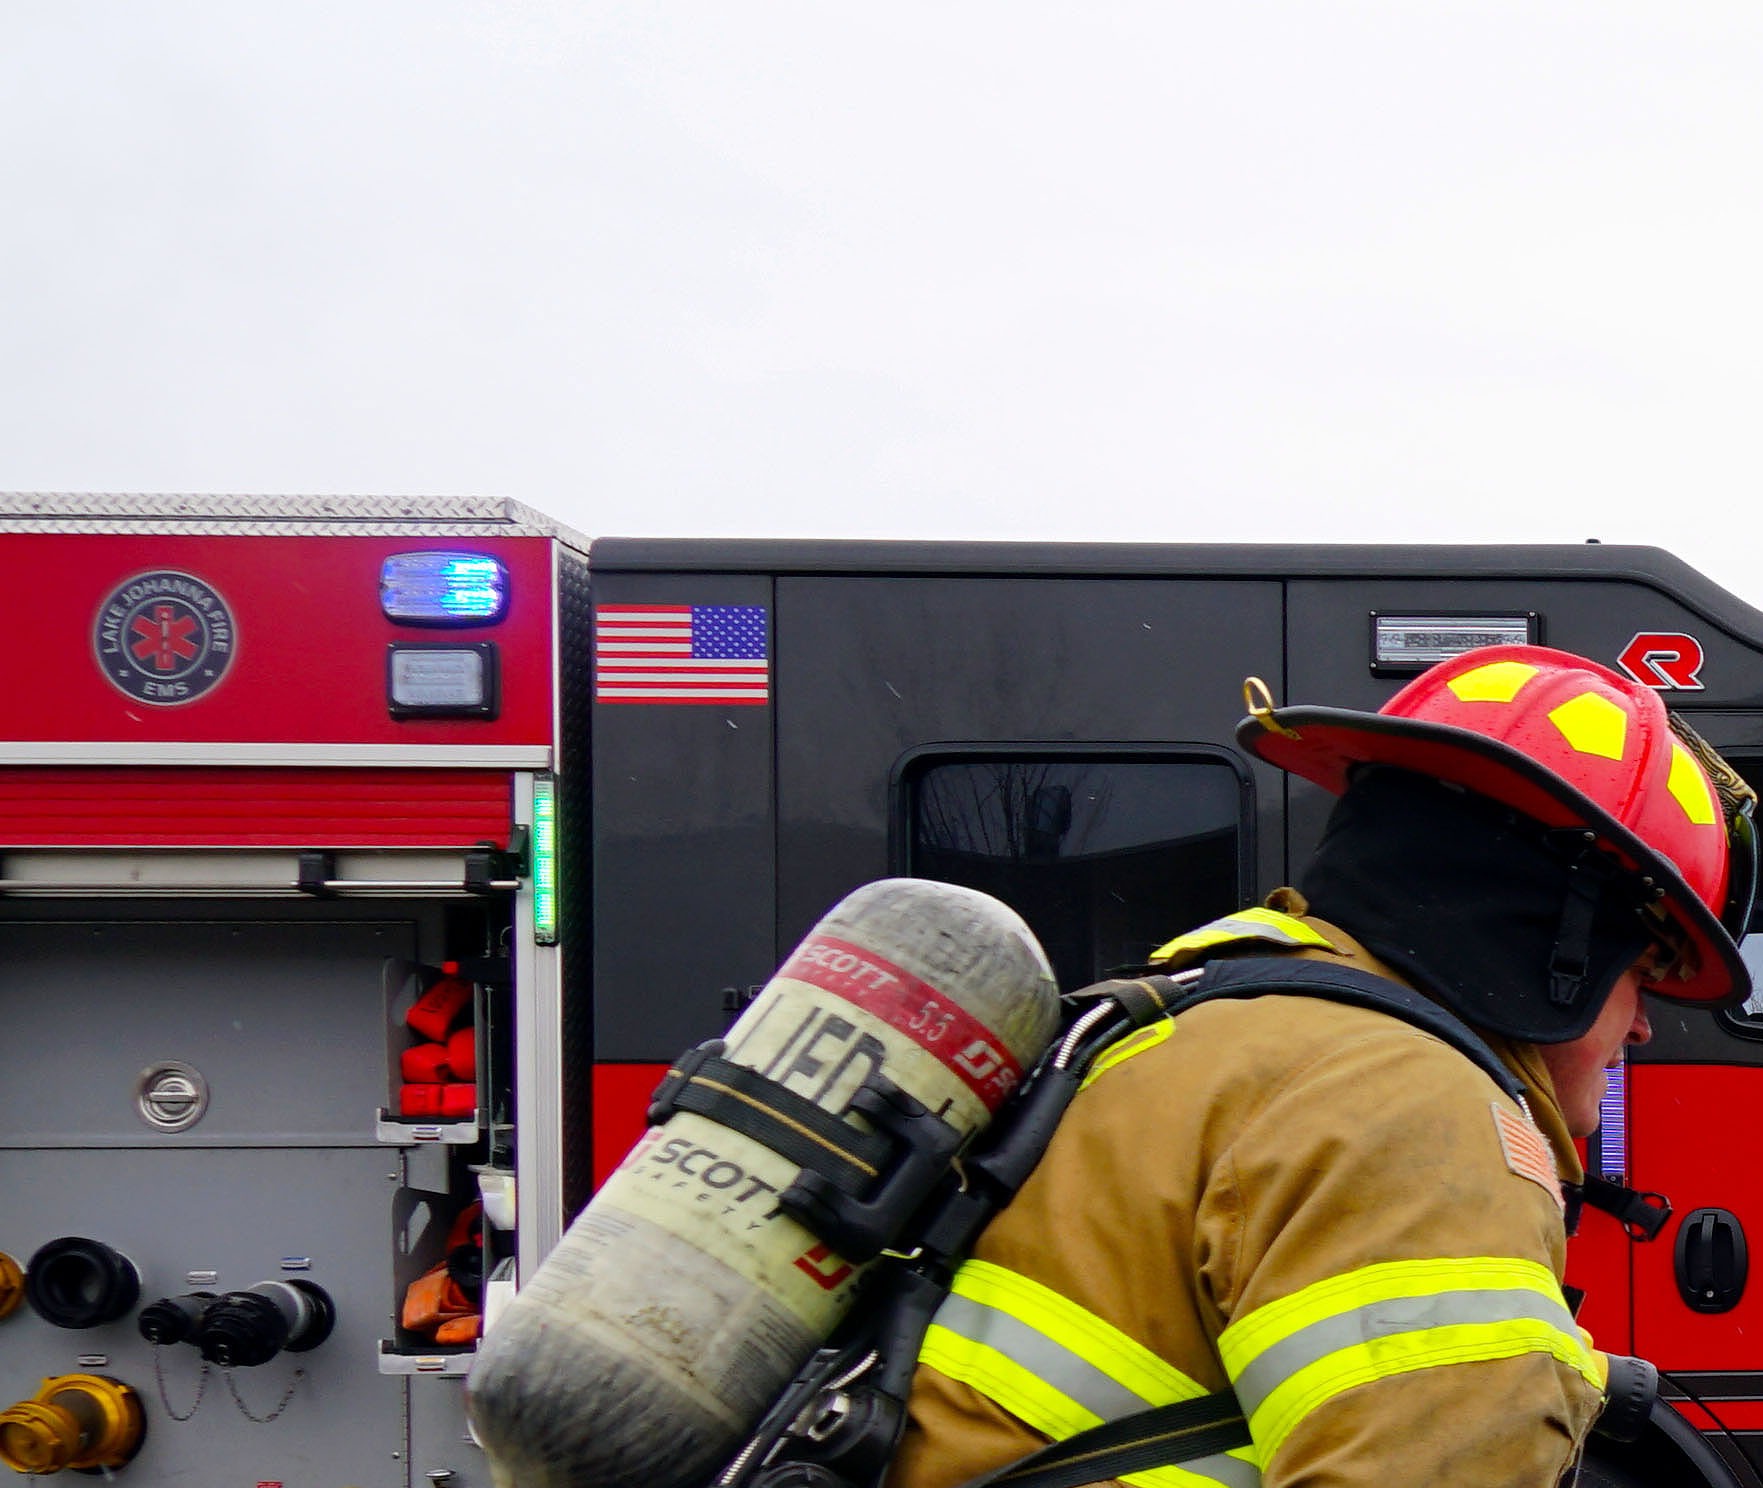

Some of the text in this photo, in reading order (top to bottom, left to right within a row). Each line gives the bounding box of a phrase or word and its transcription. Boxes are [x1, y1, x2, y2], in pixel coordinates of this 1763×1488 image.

[102, 578, 229, 654] LAKE JOHANNA FIRE
[142, 680, 189, 697] EMS
[800, 944, 899, 990] SCOTT
